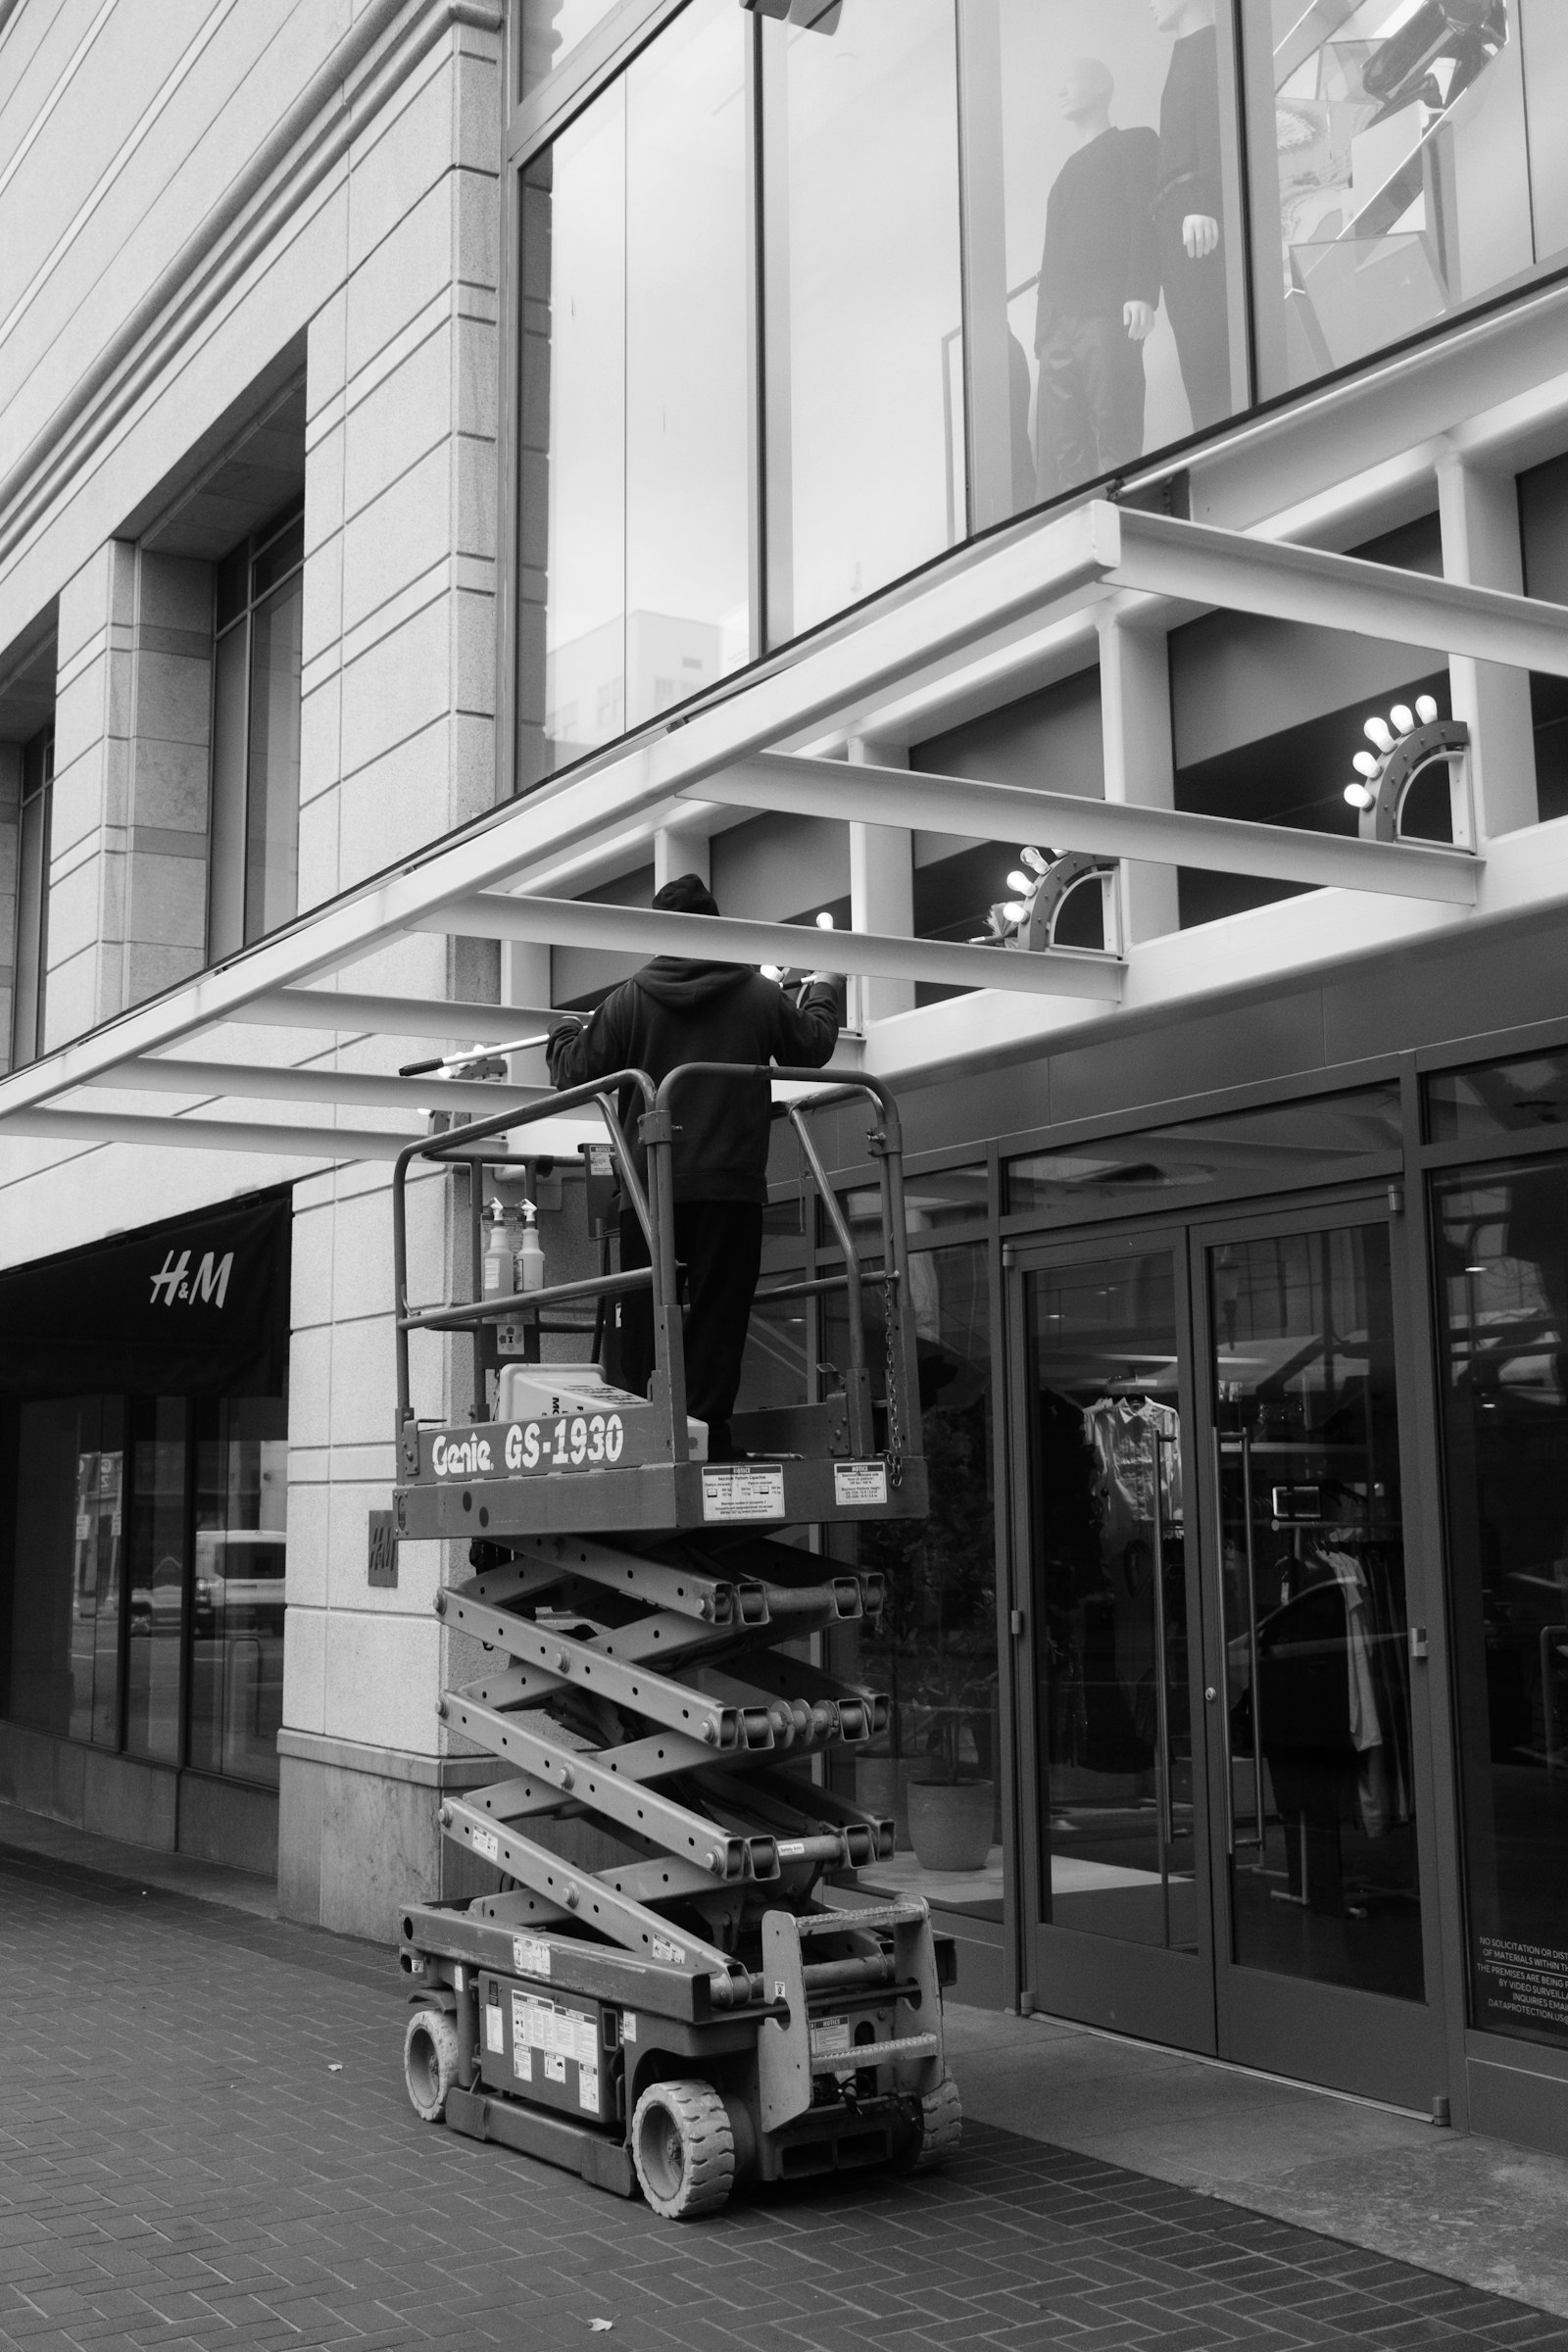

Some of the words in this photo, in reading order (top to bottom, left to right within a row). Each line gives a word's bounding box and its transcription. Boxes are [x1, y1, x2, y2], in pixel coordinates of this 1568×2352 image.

[150, 1250, 234, 1308] H&M
[432, 1432, 492, 1476] Genie
[505, 1414, 624, 1470] GS-1930
[1479, 1936, 1491, 1945] NO
[1492, 1938, 1541, 1955] SOLICITATION
[1541, 1948, 1551, 1957] OR
[1494, 1950, 1533, 1965] MATERIALS
[1534, 1958, 1559, 1971] WITHIN
[1477, 1962, 1491, 1973] THE
[1492, 1965, 1525, 1980] PREMISES
[1526, 1973, 1541, 1984] ARE
[1542, 1976, 1564, 1988] BEING
[1498, 1978, 1507, 1986] BY
[1509, 1982, 1531, 1992] VIDEO
[1512, 1992, 1547, 2007] INQUIRIES
[822, 2018, 840, 2027] NOTICE
